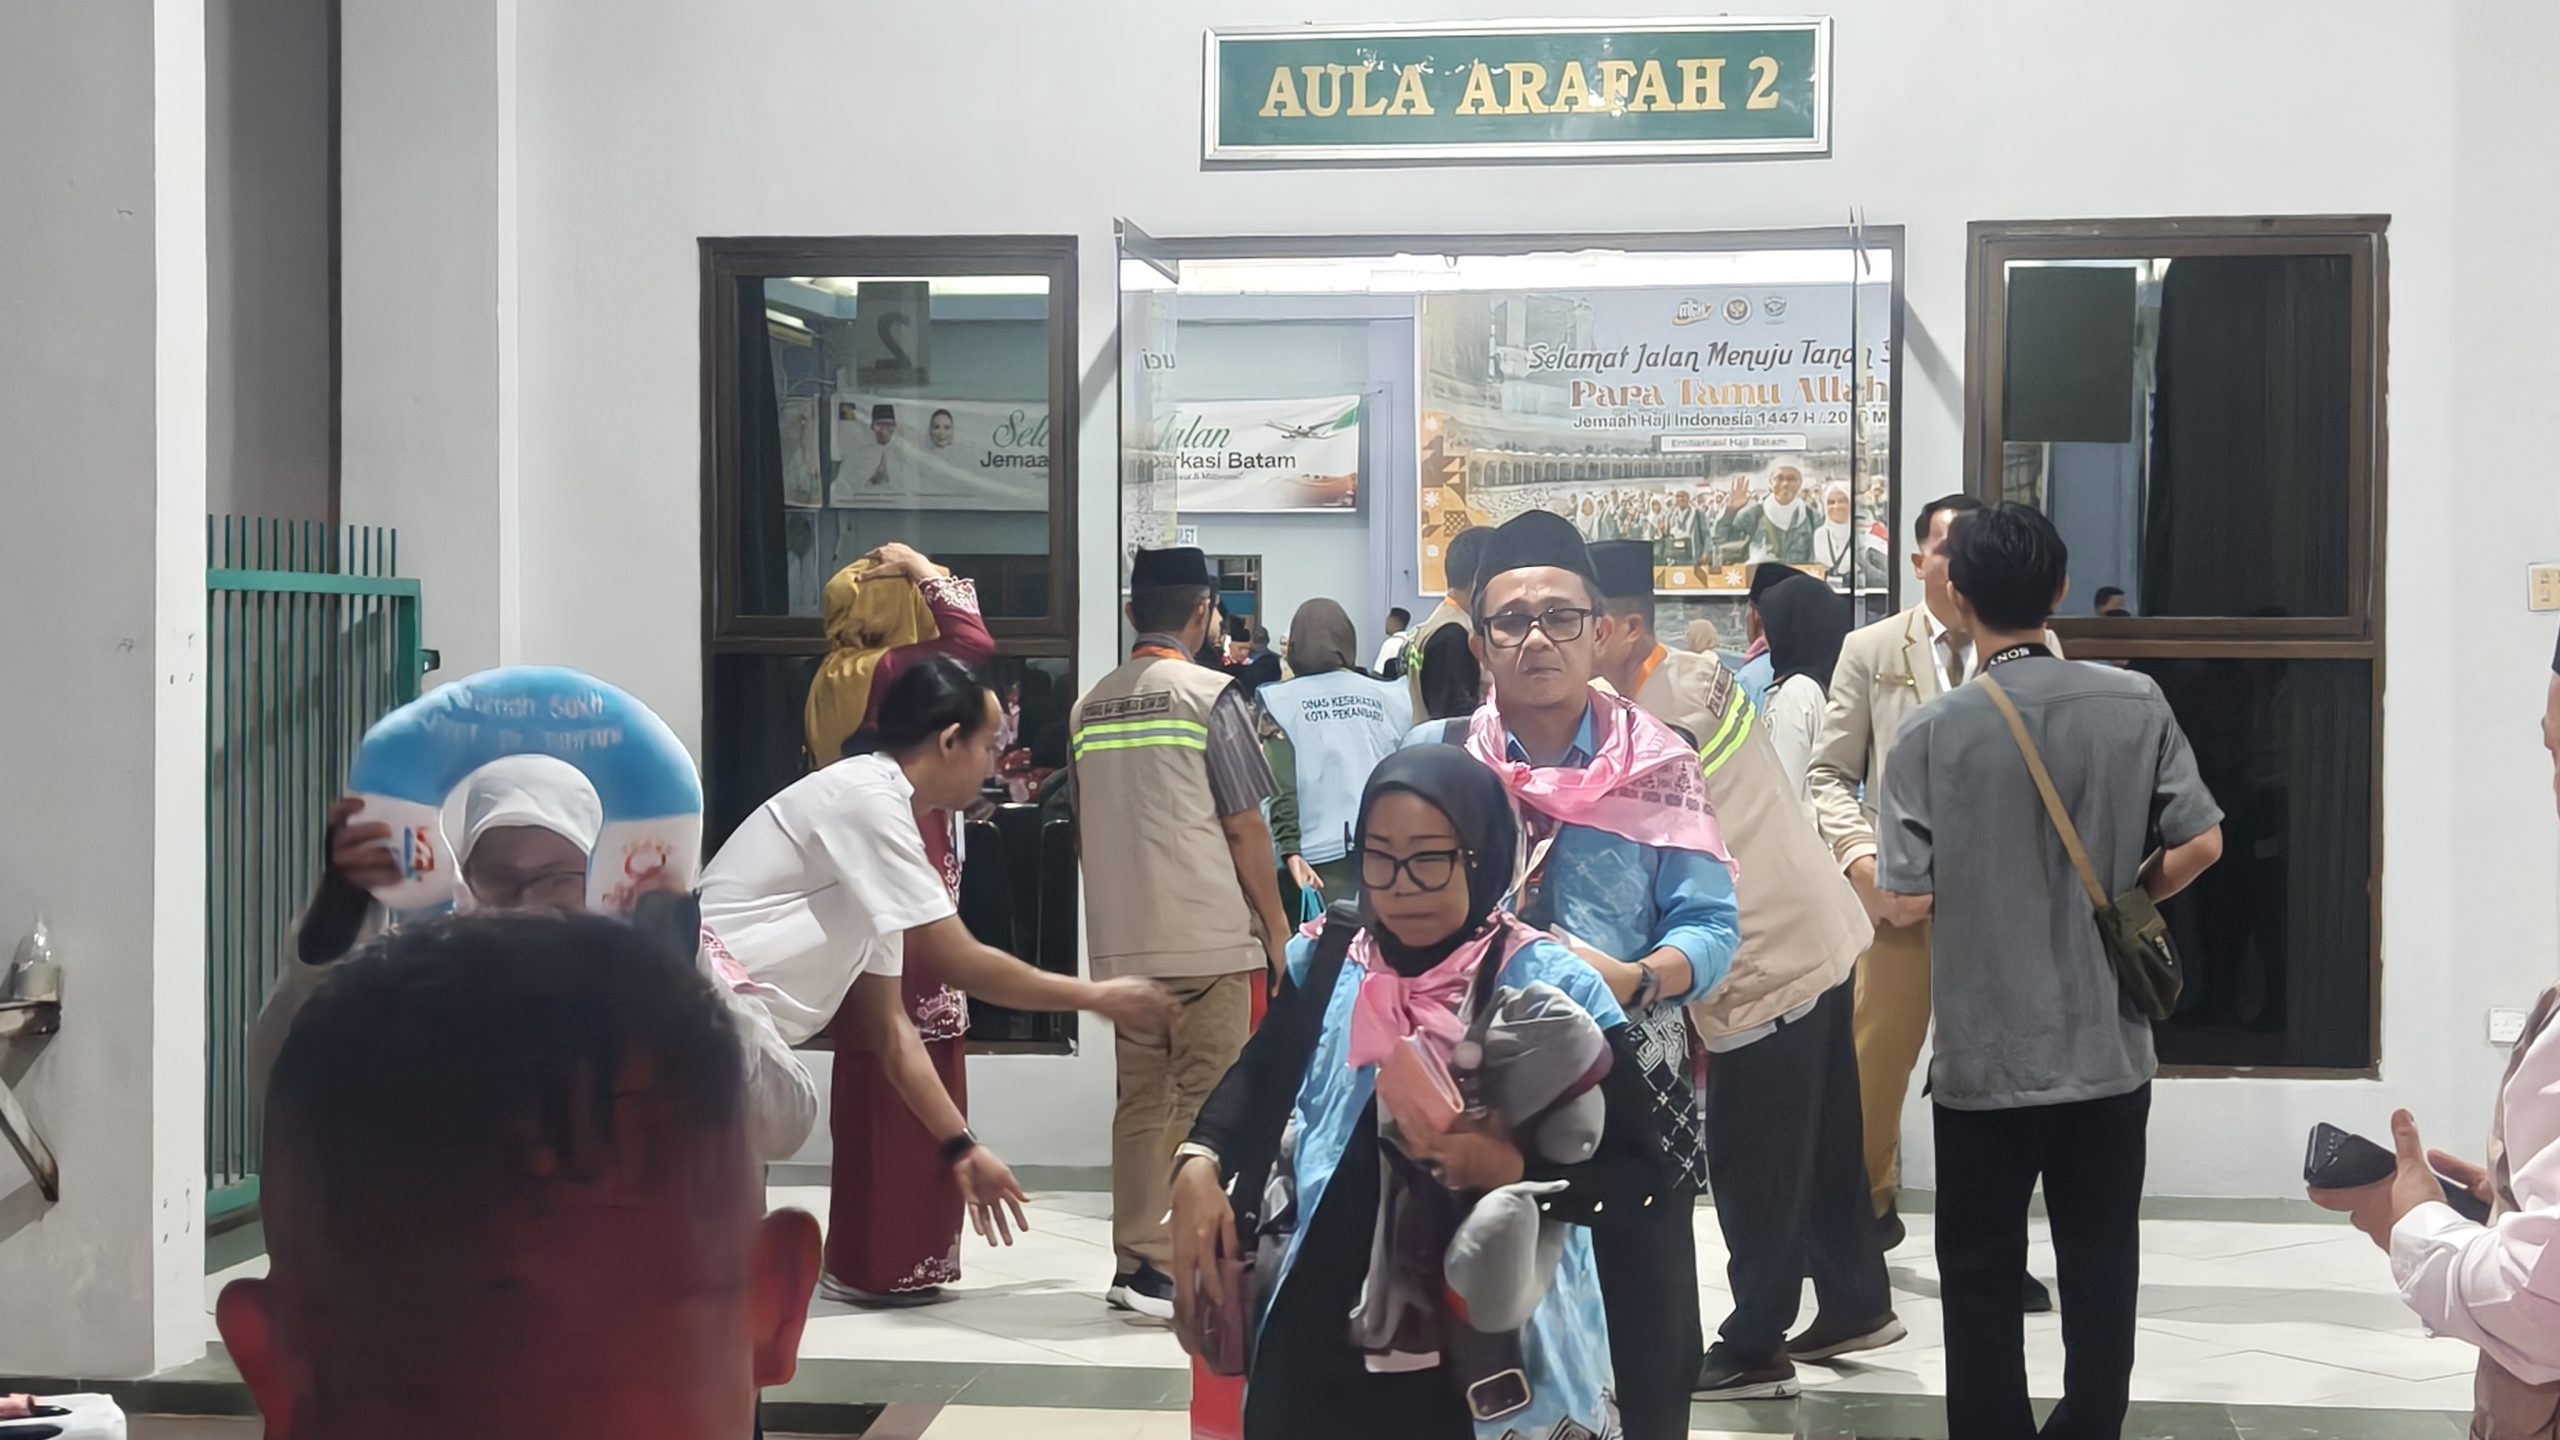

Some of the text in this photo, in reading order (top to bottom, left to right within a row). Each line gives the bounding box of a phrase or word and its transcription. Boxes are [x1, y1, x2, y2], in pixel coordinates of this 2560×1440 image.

[1258, 55, 1781, 118] AULA ARAFAH 2
[1529, 344, 1630, 374] Selamat
[1632, 343, 1700, 374] Jalan
[1707, 341, 1794, 372] Menuju
[1571, 380, 1664, 407] Para
[1674, 378, 1782, 406] Tamu
[1574, 413, 1637, 428] Jemaah
[1641, 413, 1671, 430] Haji
[1675, 412, 1753, 427] Indonesia
[1758, 411, 1799, 425] 1447
[1804, 410, 1815, 424] H
[1872, 410, 1887, 424] M
[1228, 451, 1296, 469] Batam
[1304, 709, 1331, 722] KOTA
